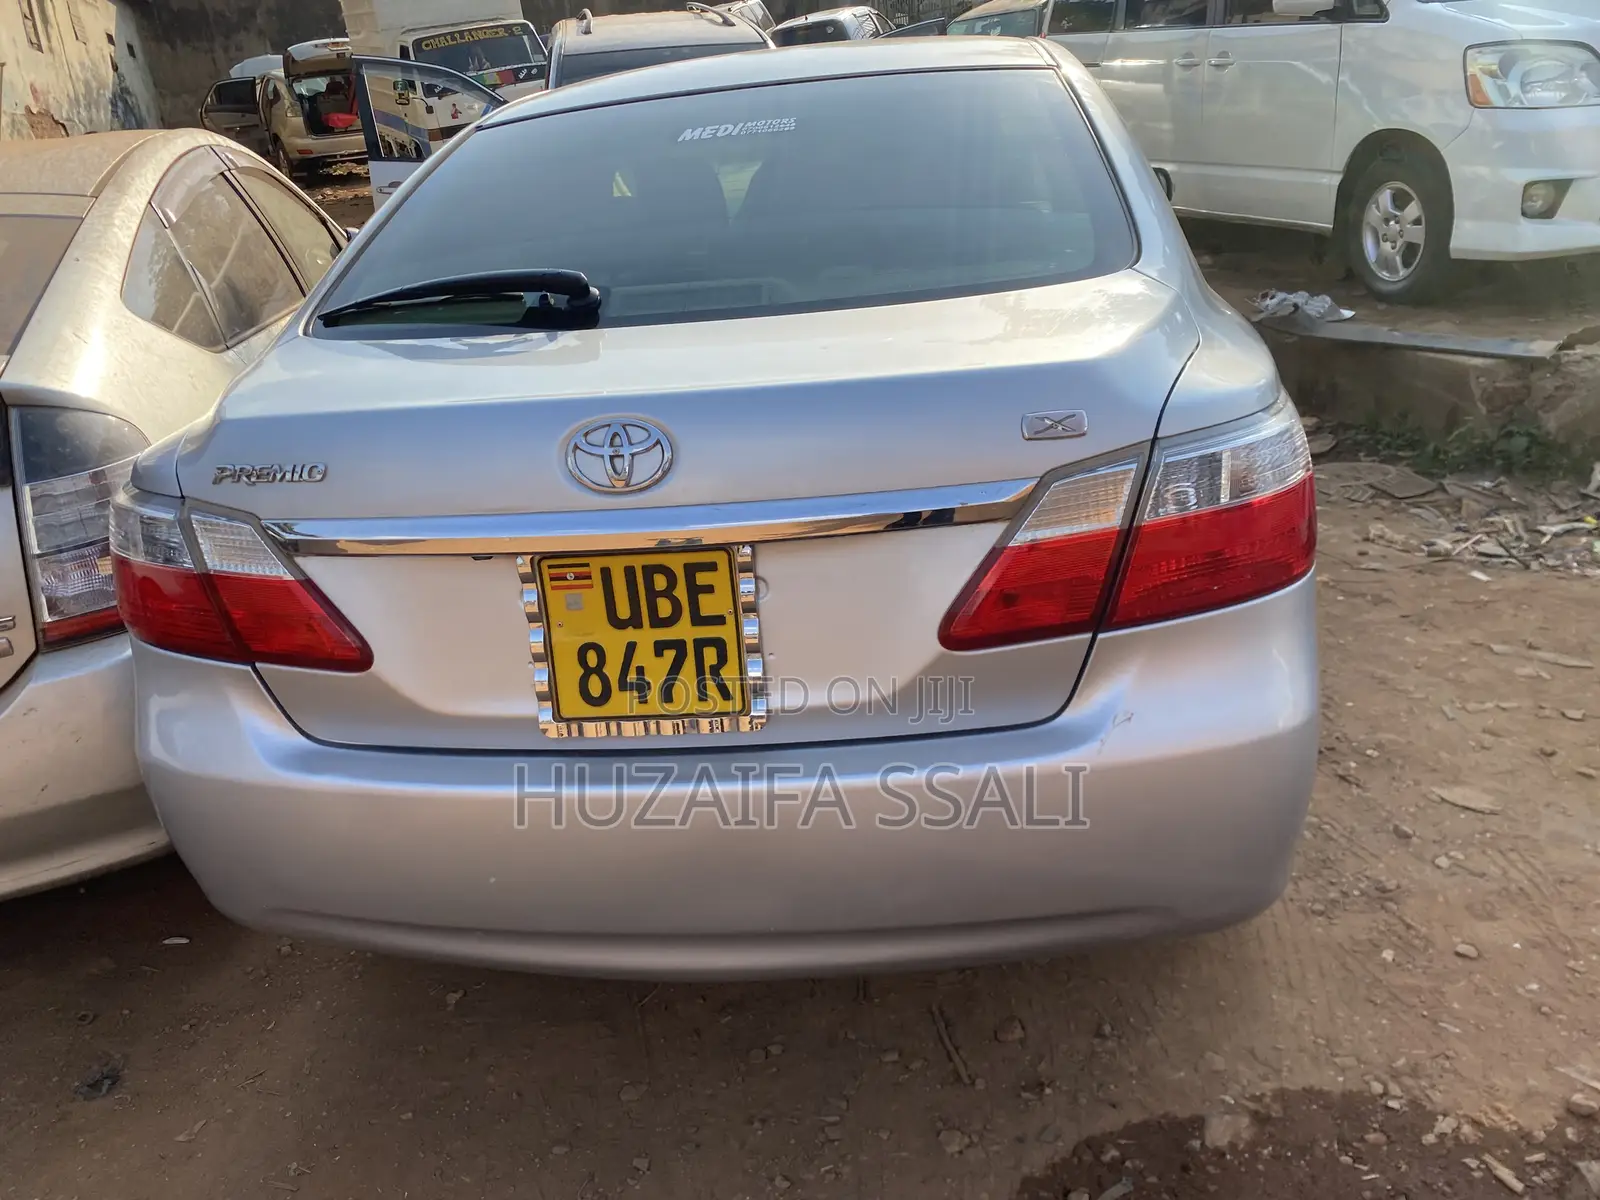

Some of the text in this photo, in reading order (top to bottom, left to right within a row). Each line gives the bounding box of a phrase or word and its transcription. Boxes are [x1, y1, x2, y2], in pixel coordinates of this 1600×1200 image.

[677, 122, 744, 142] MEDI
[744, 117, 797, 127] MOTORS
[212, 462, 328, 486] PREMIO
[600, 561, 727, 630] UBE
[577, 636, 734, 707] 847R
